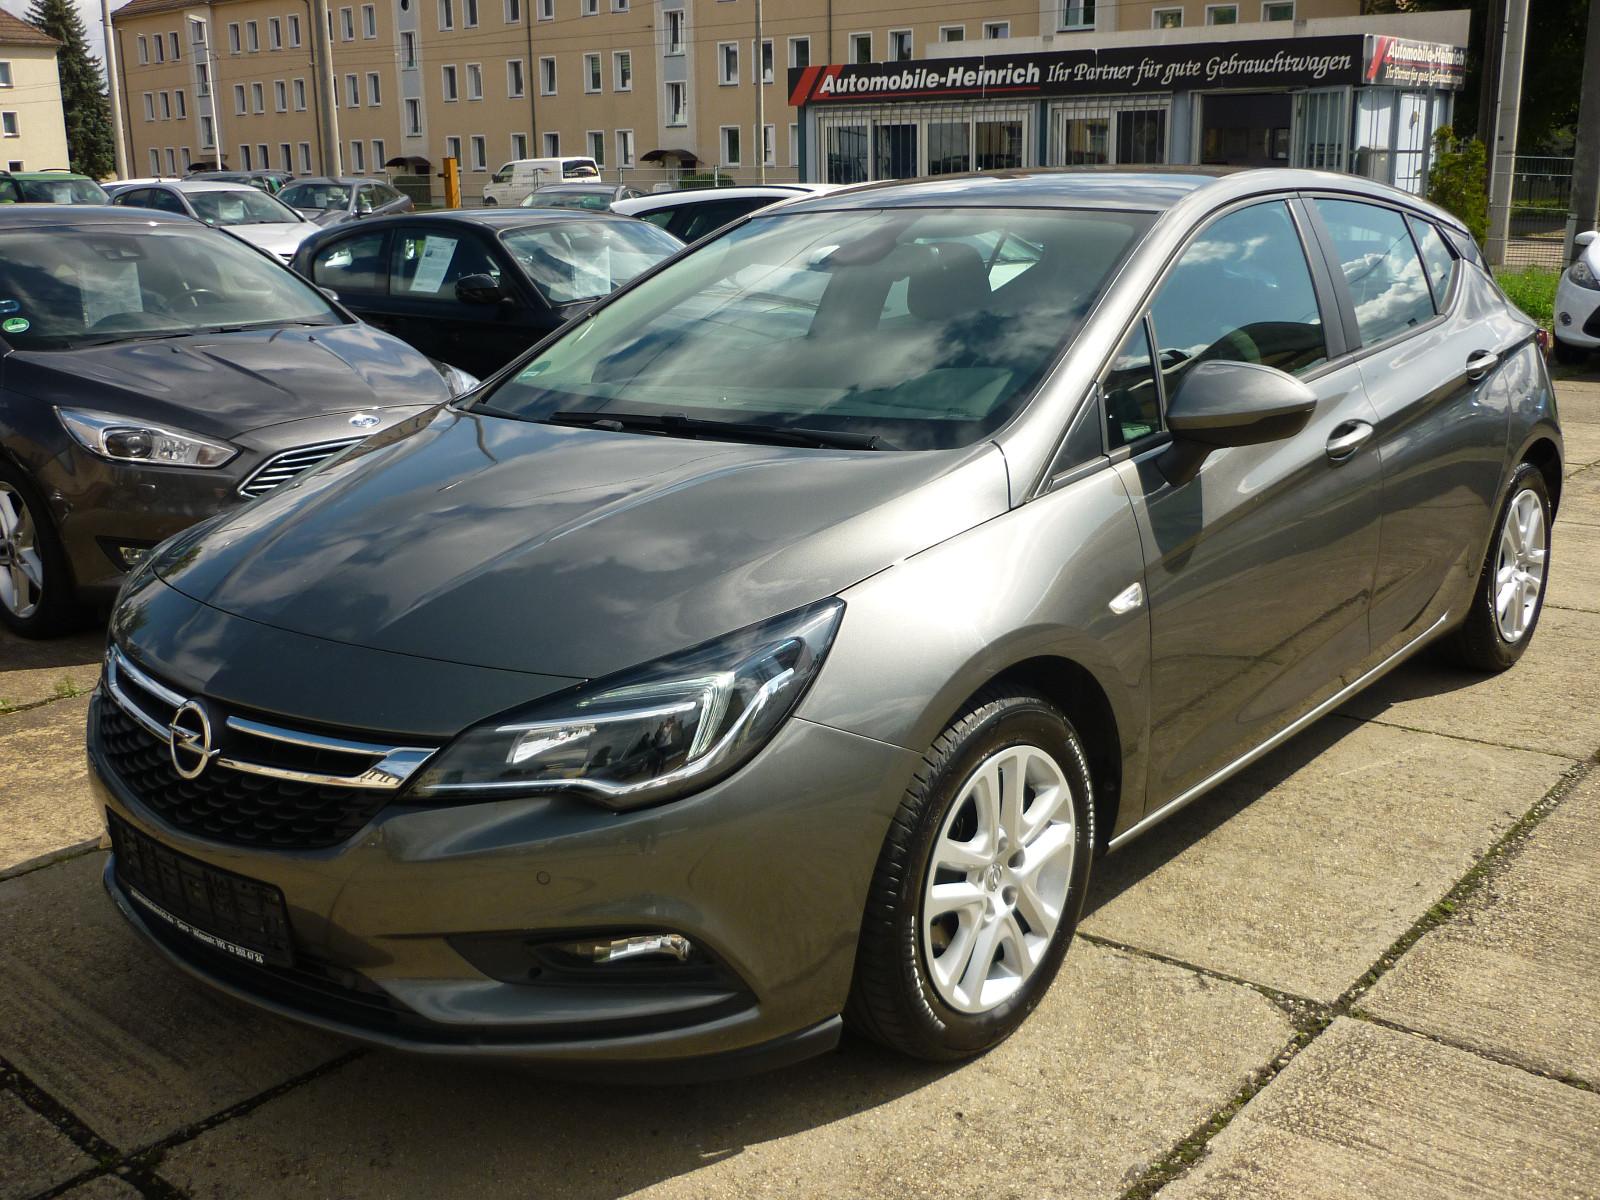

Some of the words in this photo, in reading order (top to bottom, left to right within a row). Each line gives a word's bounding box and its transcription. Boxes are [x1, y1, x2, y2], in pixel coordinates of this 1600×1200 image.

[1386, 40, 1465, 66] Automobile-Heinrich
[820, 63, 1040, 93] Automobile-Heinrich
[1046, 62, 1071, 82] Ihr
[1074, 63, 1134, 81] Partner
[1132, 57, 1162, 86] für
[1161, 59, 1201, 85] gute
[1205, 51, 1352, 81] Gebrauchtwagen
